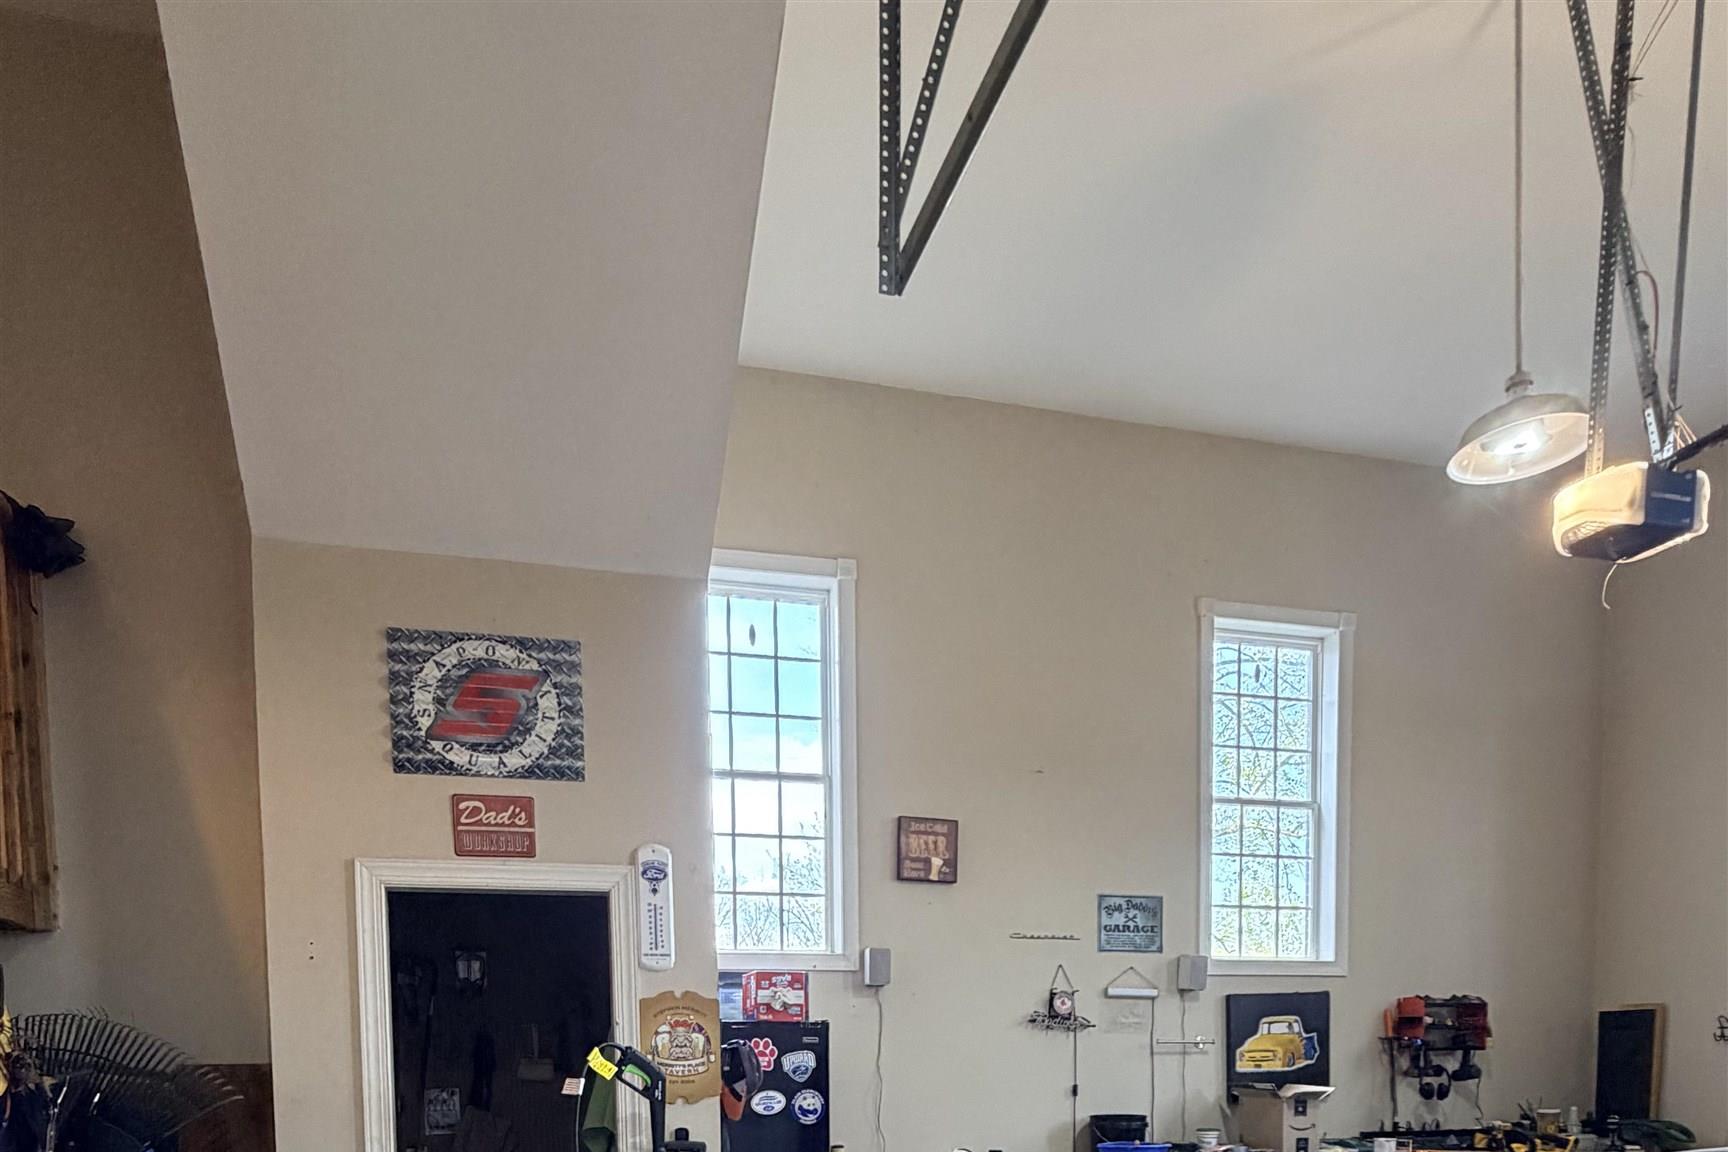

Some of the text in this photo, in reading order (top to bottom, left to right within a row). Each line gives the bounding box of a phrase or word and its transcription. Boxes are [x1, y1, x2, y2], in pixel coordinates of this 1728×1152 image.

[441, 689, 556, 770] QUALITY
[458, 800, 529, 826] Dad's
[463, 832, 530, 852] WORKSHOP
[909, 833, 949, 859] BEER
[642, 867, 667, 880] Ford
[1103, 924, 1159, 934] GARAGE
[664, 1067, 700, 1076] TAVERN
